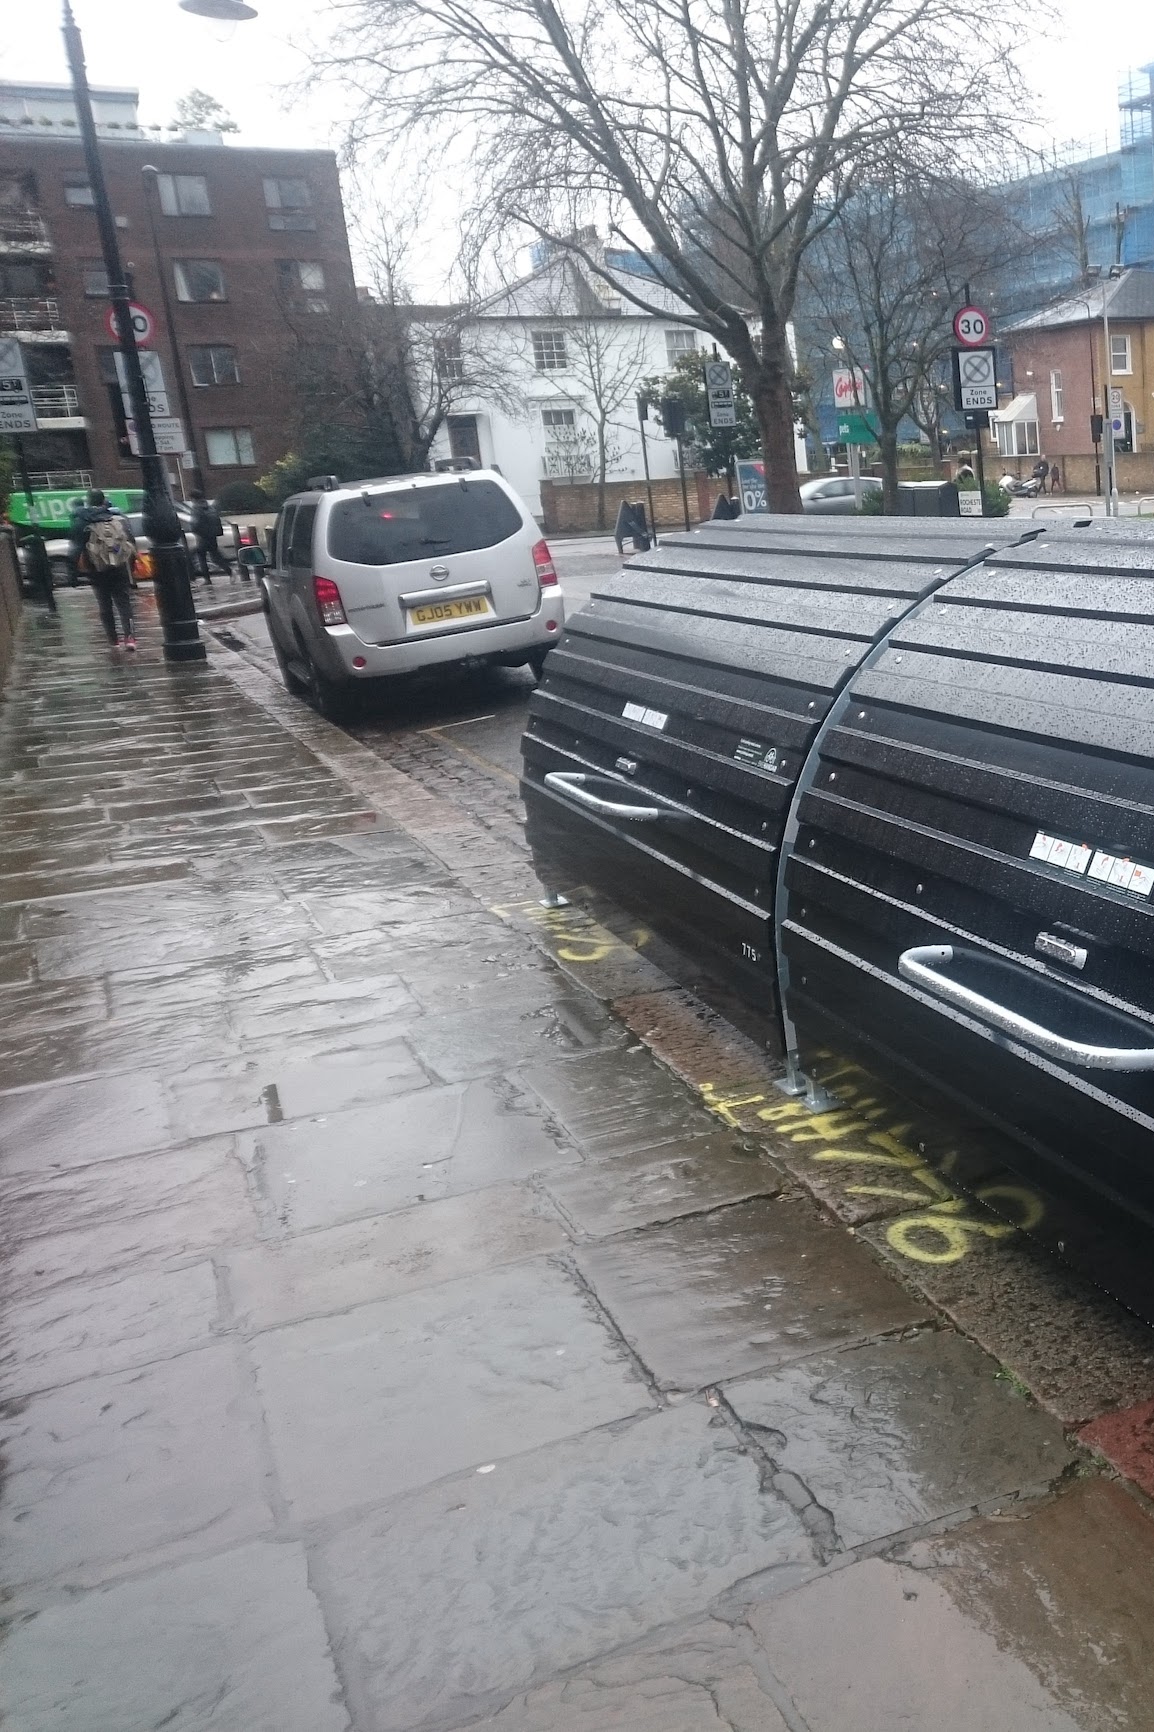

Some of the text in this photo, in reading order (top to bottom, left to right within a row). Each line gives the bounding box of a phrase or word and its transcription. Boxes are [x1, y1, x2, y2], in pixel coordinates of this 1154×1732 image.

[961, 319, 984, 334] 30
[966, 397, 993, 405] ENDS
[743, 490, 767, 510] 0%
[416, 600, 482, 622] GJ05 YWW
[741, 942, 757, 961] 775
